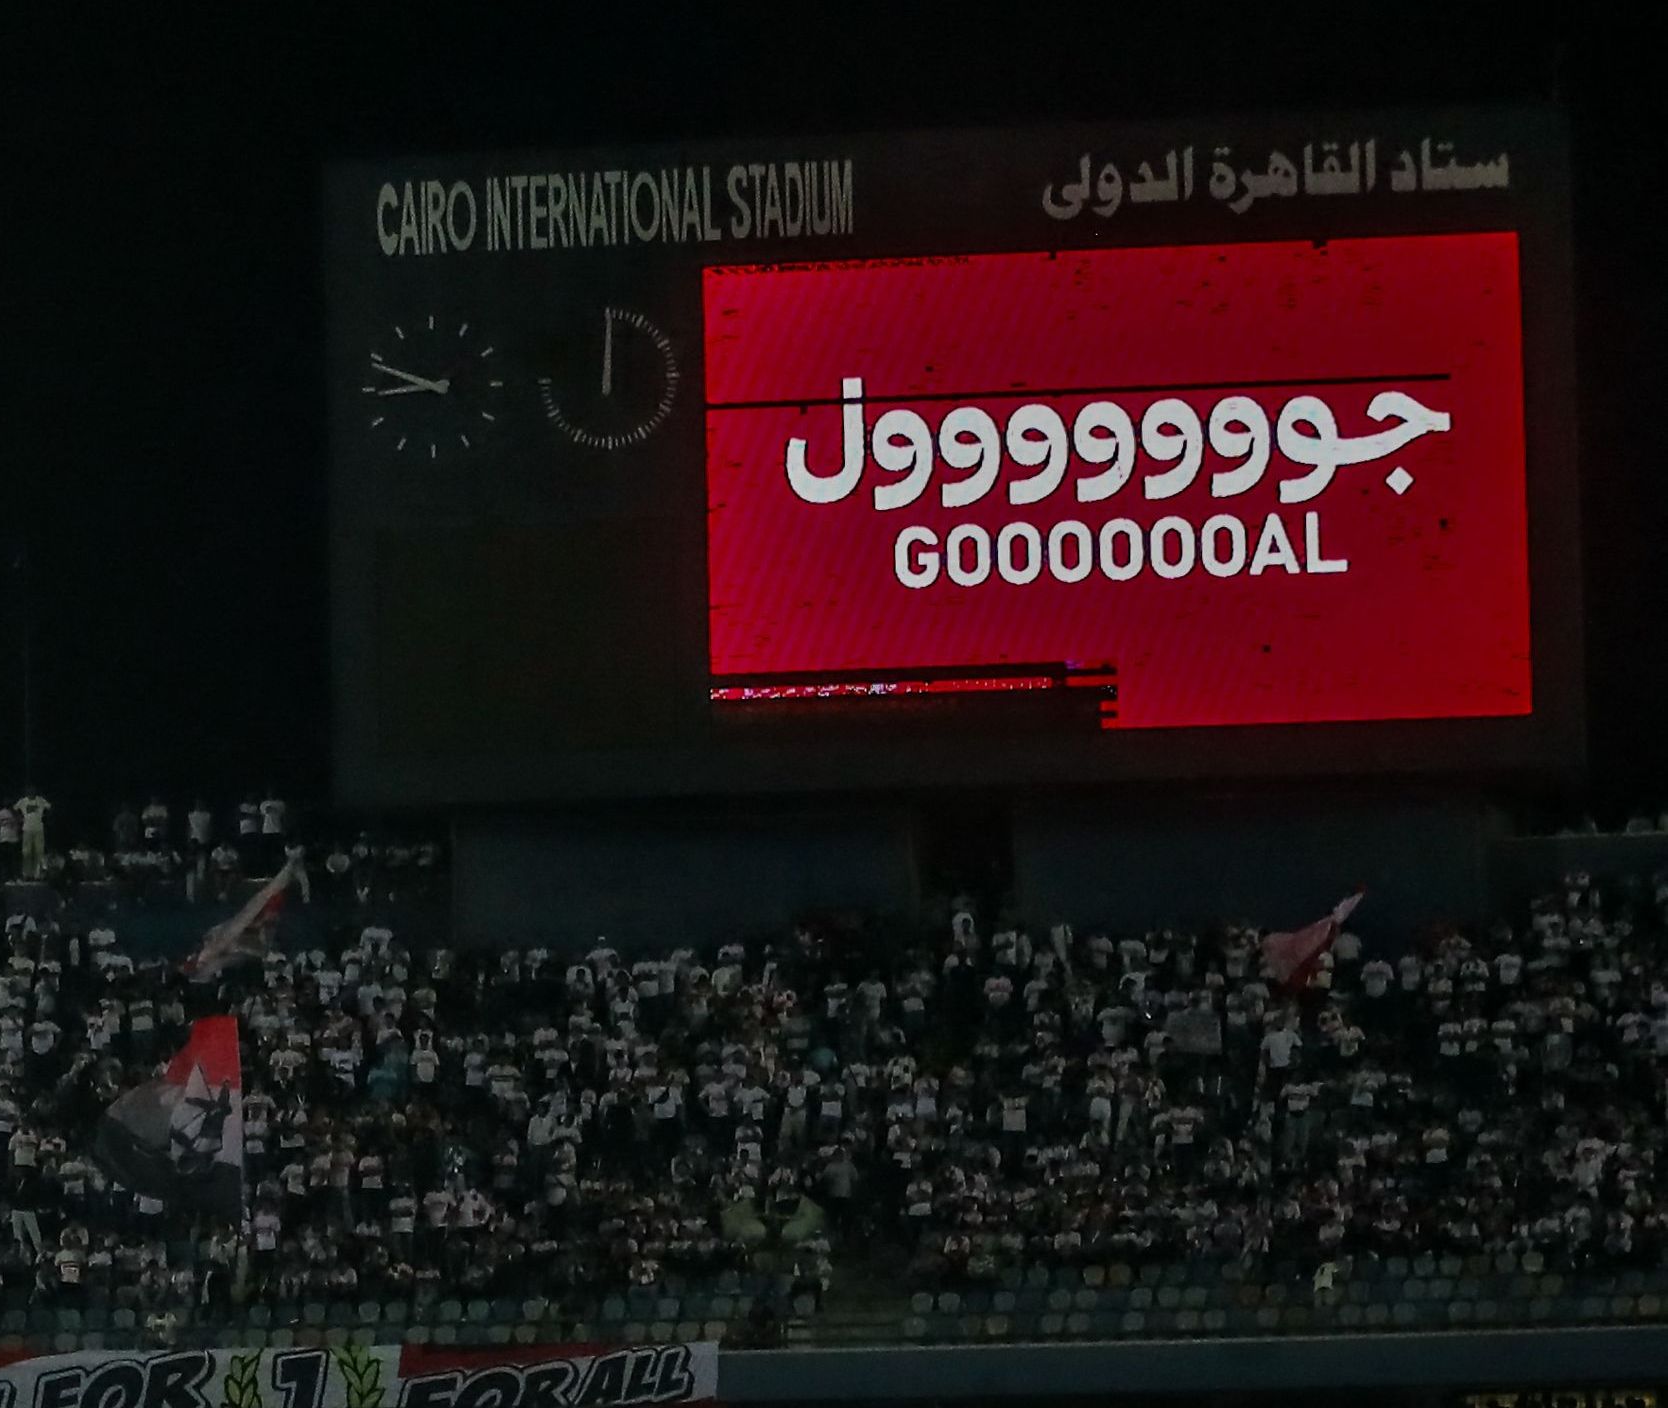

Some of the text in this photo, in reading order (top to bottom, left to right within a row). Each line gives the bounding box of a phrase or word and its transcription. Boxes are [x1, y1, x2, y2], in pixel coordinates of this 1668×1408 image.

[1208, 137, 1375, 216] القاهرة
[1389, 137, 1510, 193] ستاد
[377, 159, 854, 256] CAIRO INTERNATIONAL STADIUM
[894, 510, 1350, 590] GOOOOOOAL
